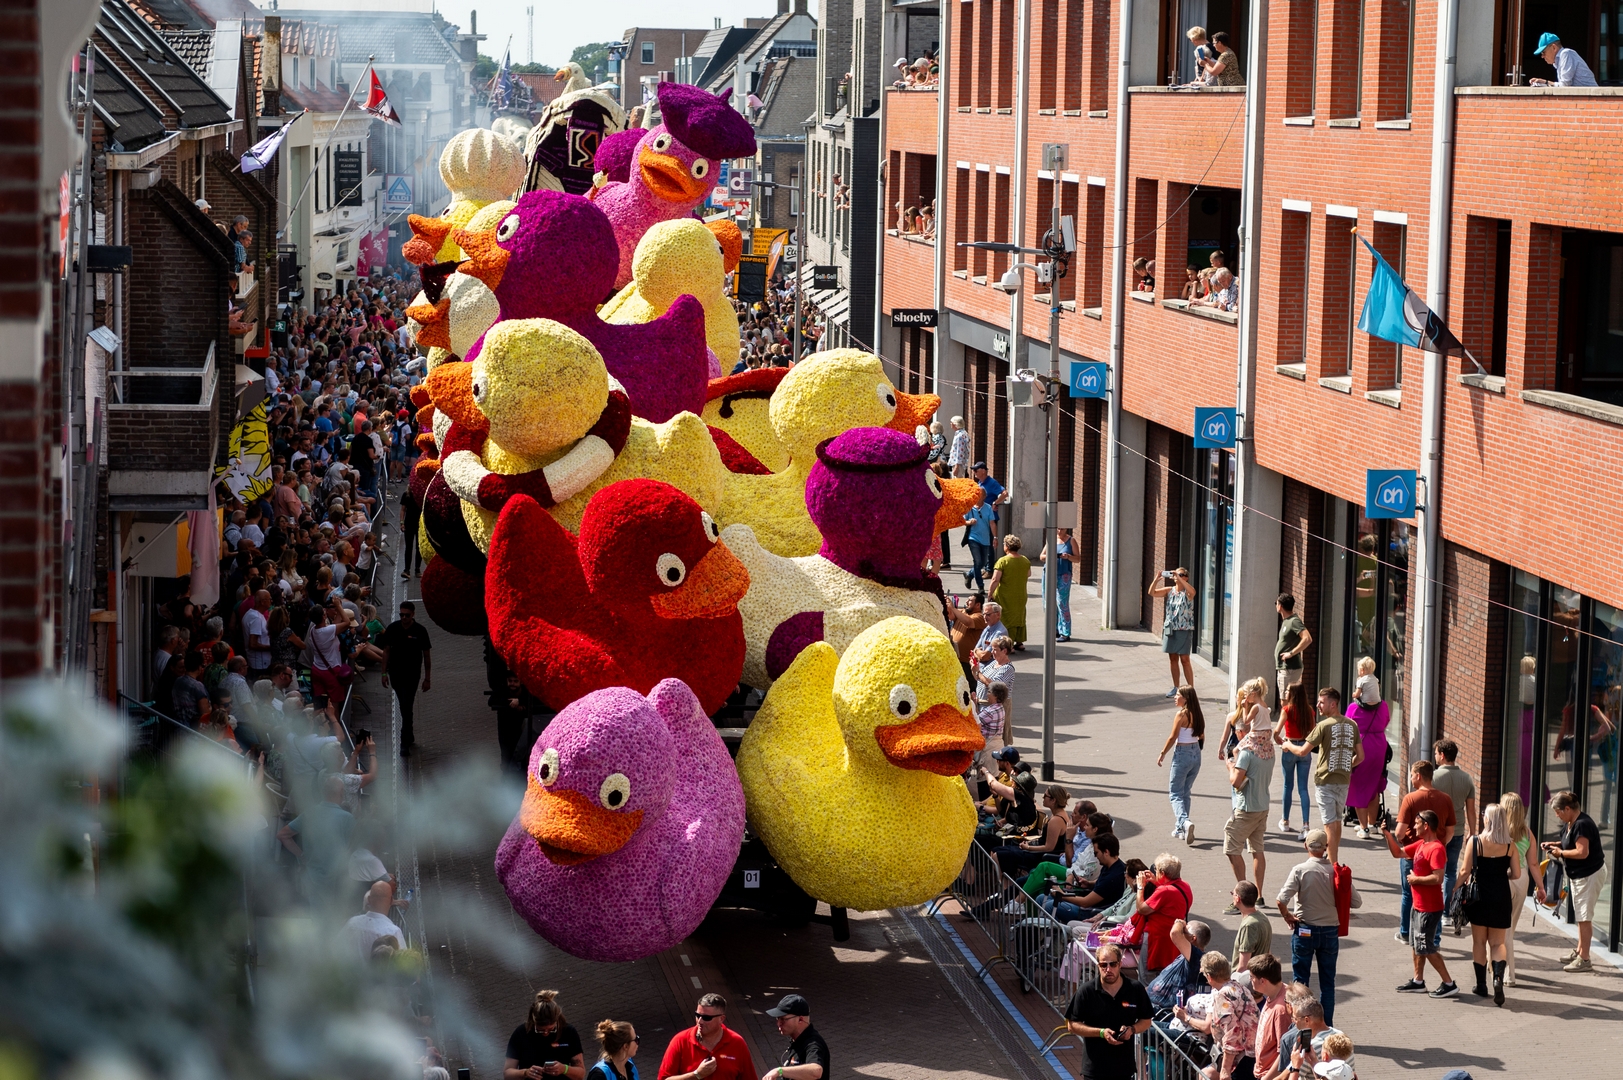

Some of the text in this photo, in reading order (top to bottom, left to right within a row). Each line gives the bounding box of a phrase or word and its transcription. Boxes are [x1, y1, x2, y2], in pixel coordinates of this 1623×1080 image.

[893, 311, 933, 325] shoeby
[1330, 724, 1338, 748] ISLAND
[745, 872, 758, 883] 01
